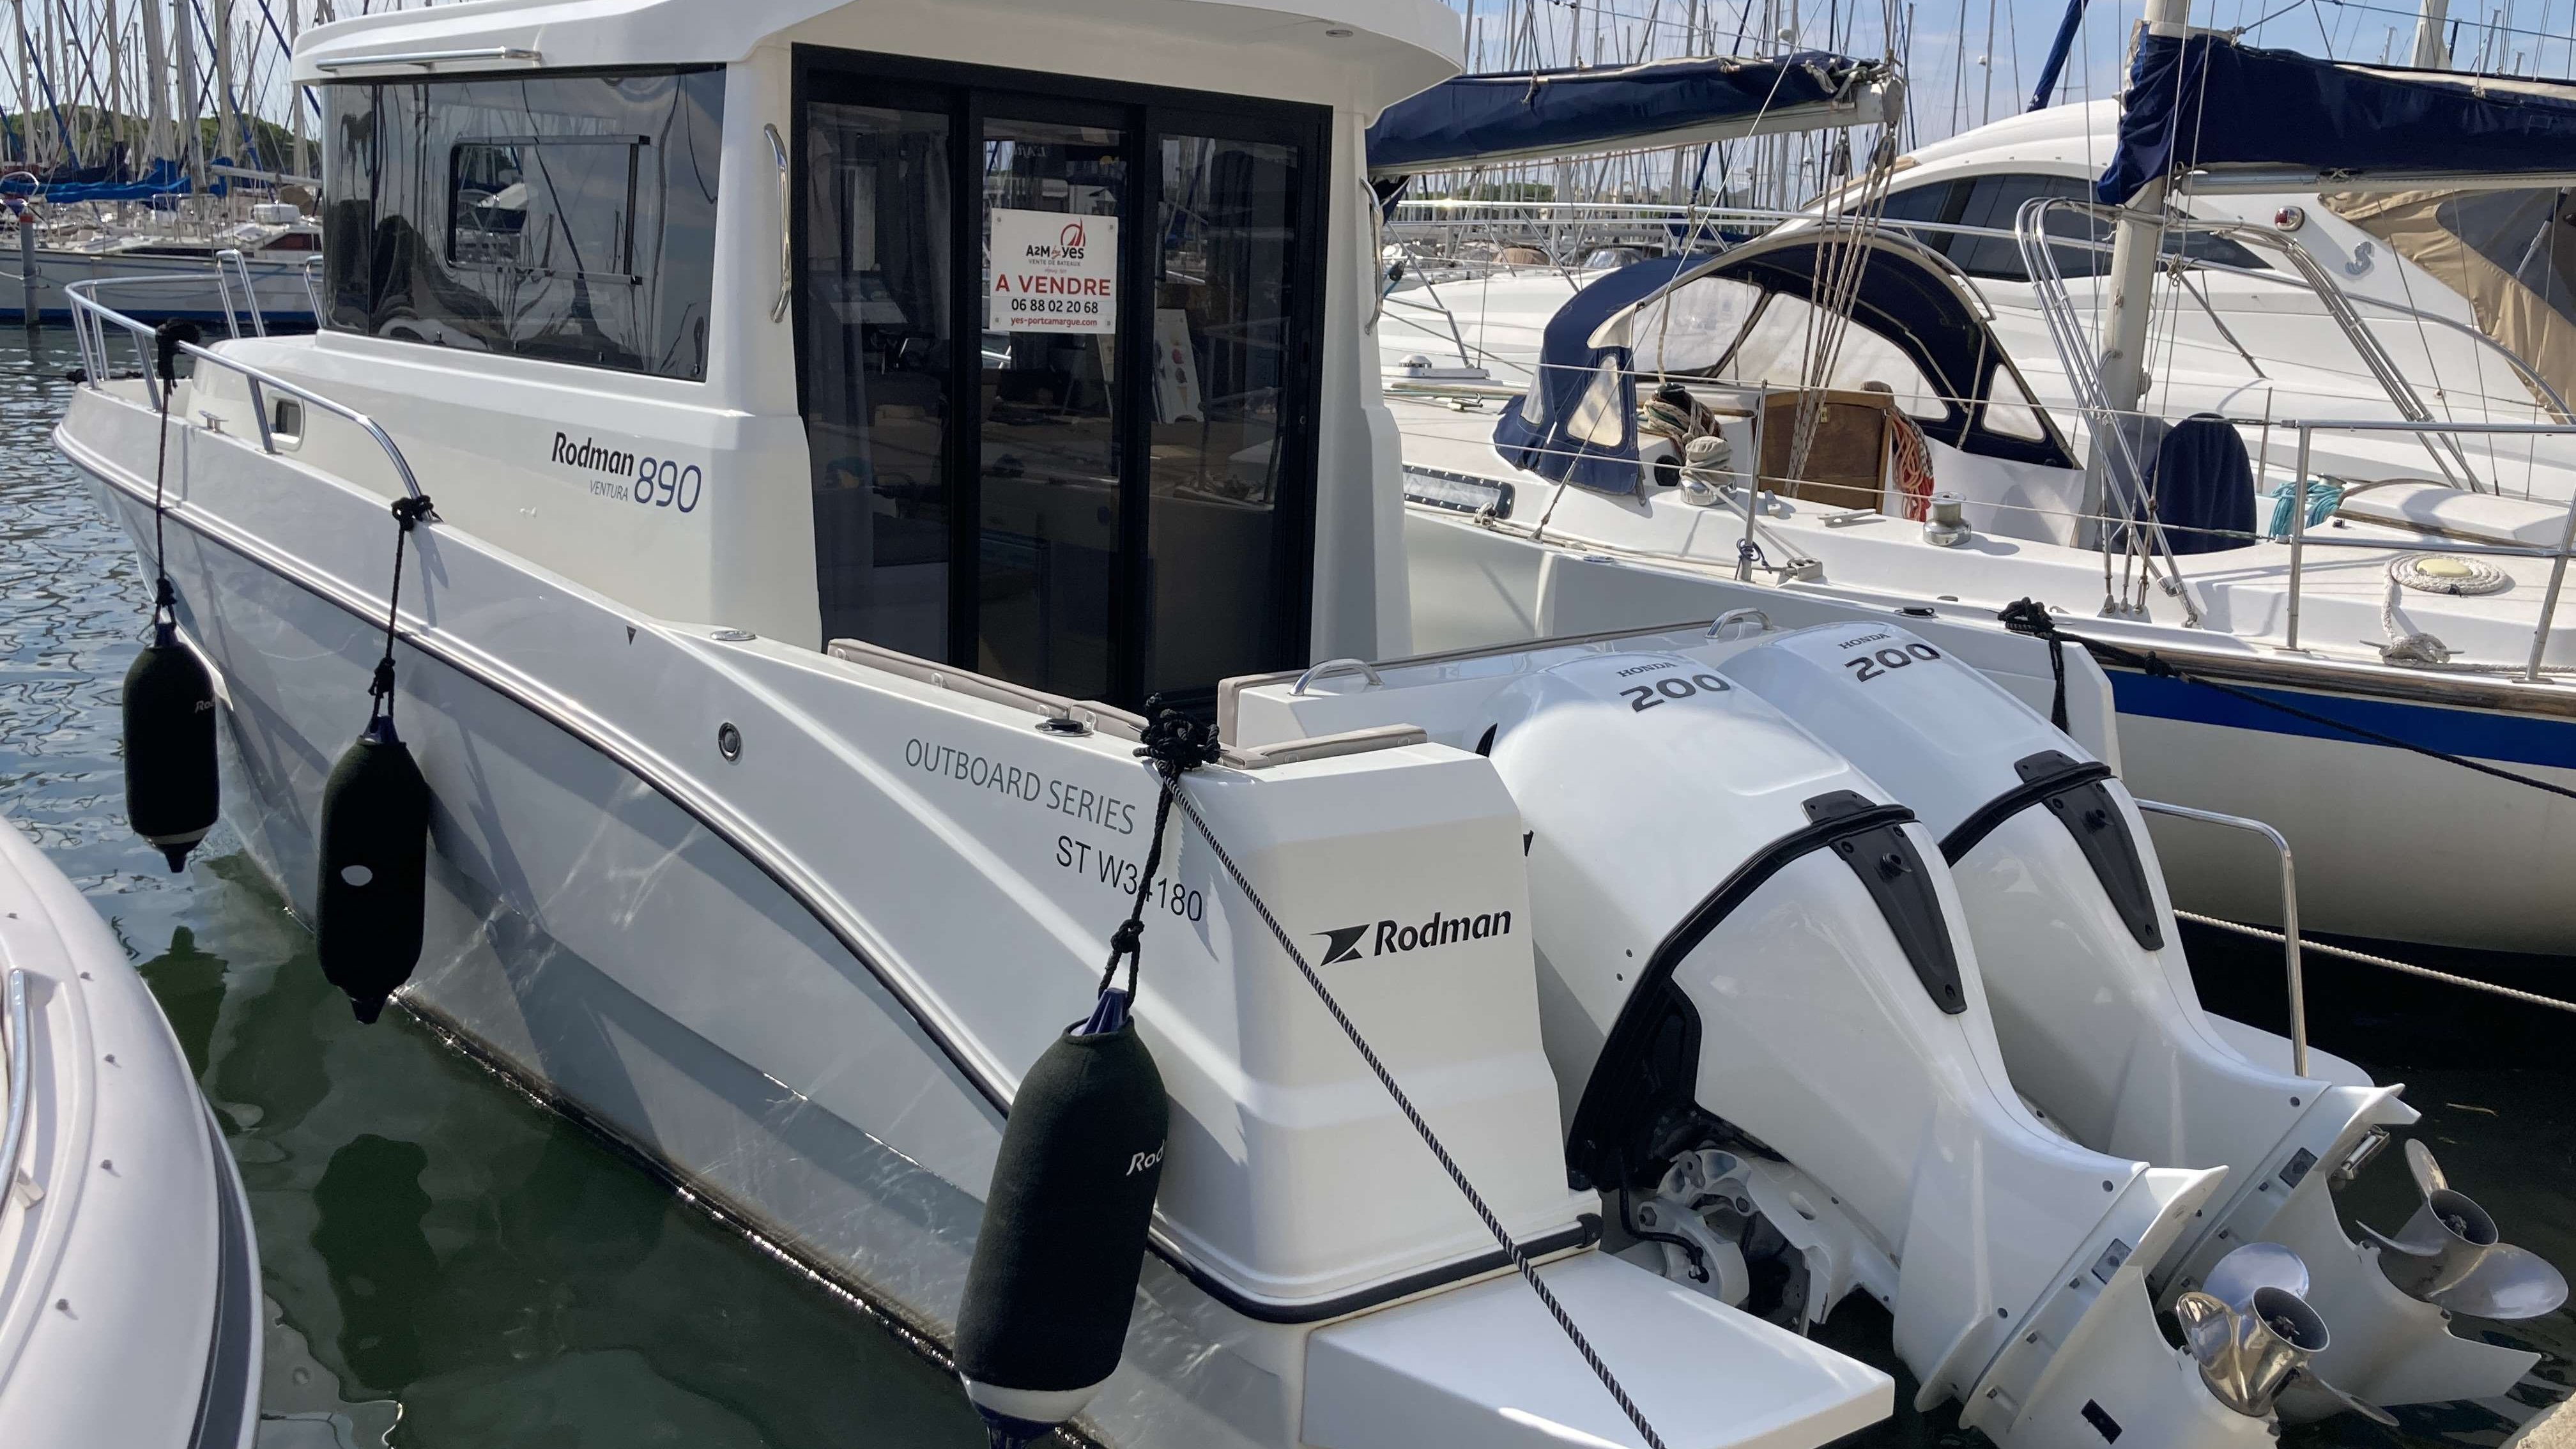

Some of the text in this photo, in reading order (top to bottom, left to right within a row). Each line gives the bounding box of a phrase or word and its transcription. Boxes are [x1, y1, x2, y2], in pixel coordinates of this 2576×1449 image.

[1062, 247, 1084, 259] yes
[995, 274, 1111, 296] A VENDRE
[1011, 298, 1098, 314] 06 88 02 20 68
[1011, 316, 1098, 328] yes-portcamargue.com
[551, 431, 702, 513] Rodman 890
[590, 479, 629, 502] VENTURA
[1837, 632, 1892, 650] HONDA
[1616, 661, 1680, 678] HONDA
[1844, 643, 1941, 683] 200
[1619, 674, 1731, 713] 200
[905, 738, 1137, 835] OUTBOARD SERIES
[1055, 835, 1091, 874] ST
[1374, 910, 1512, 956] Rodman
